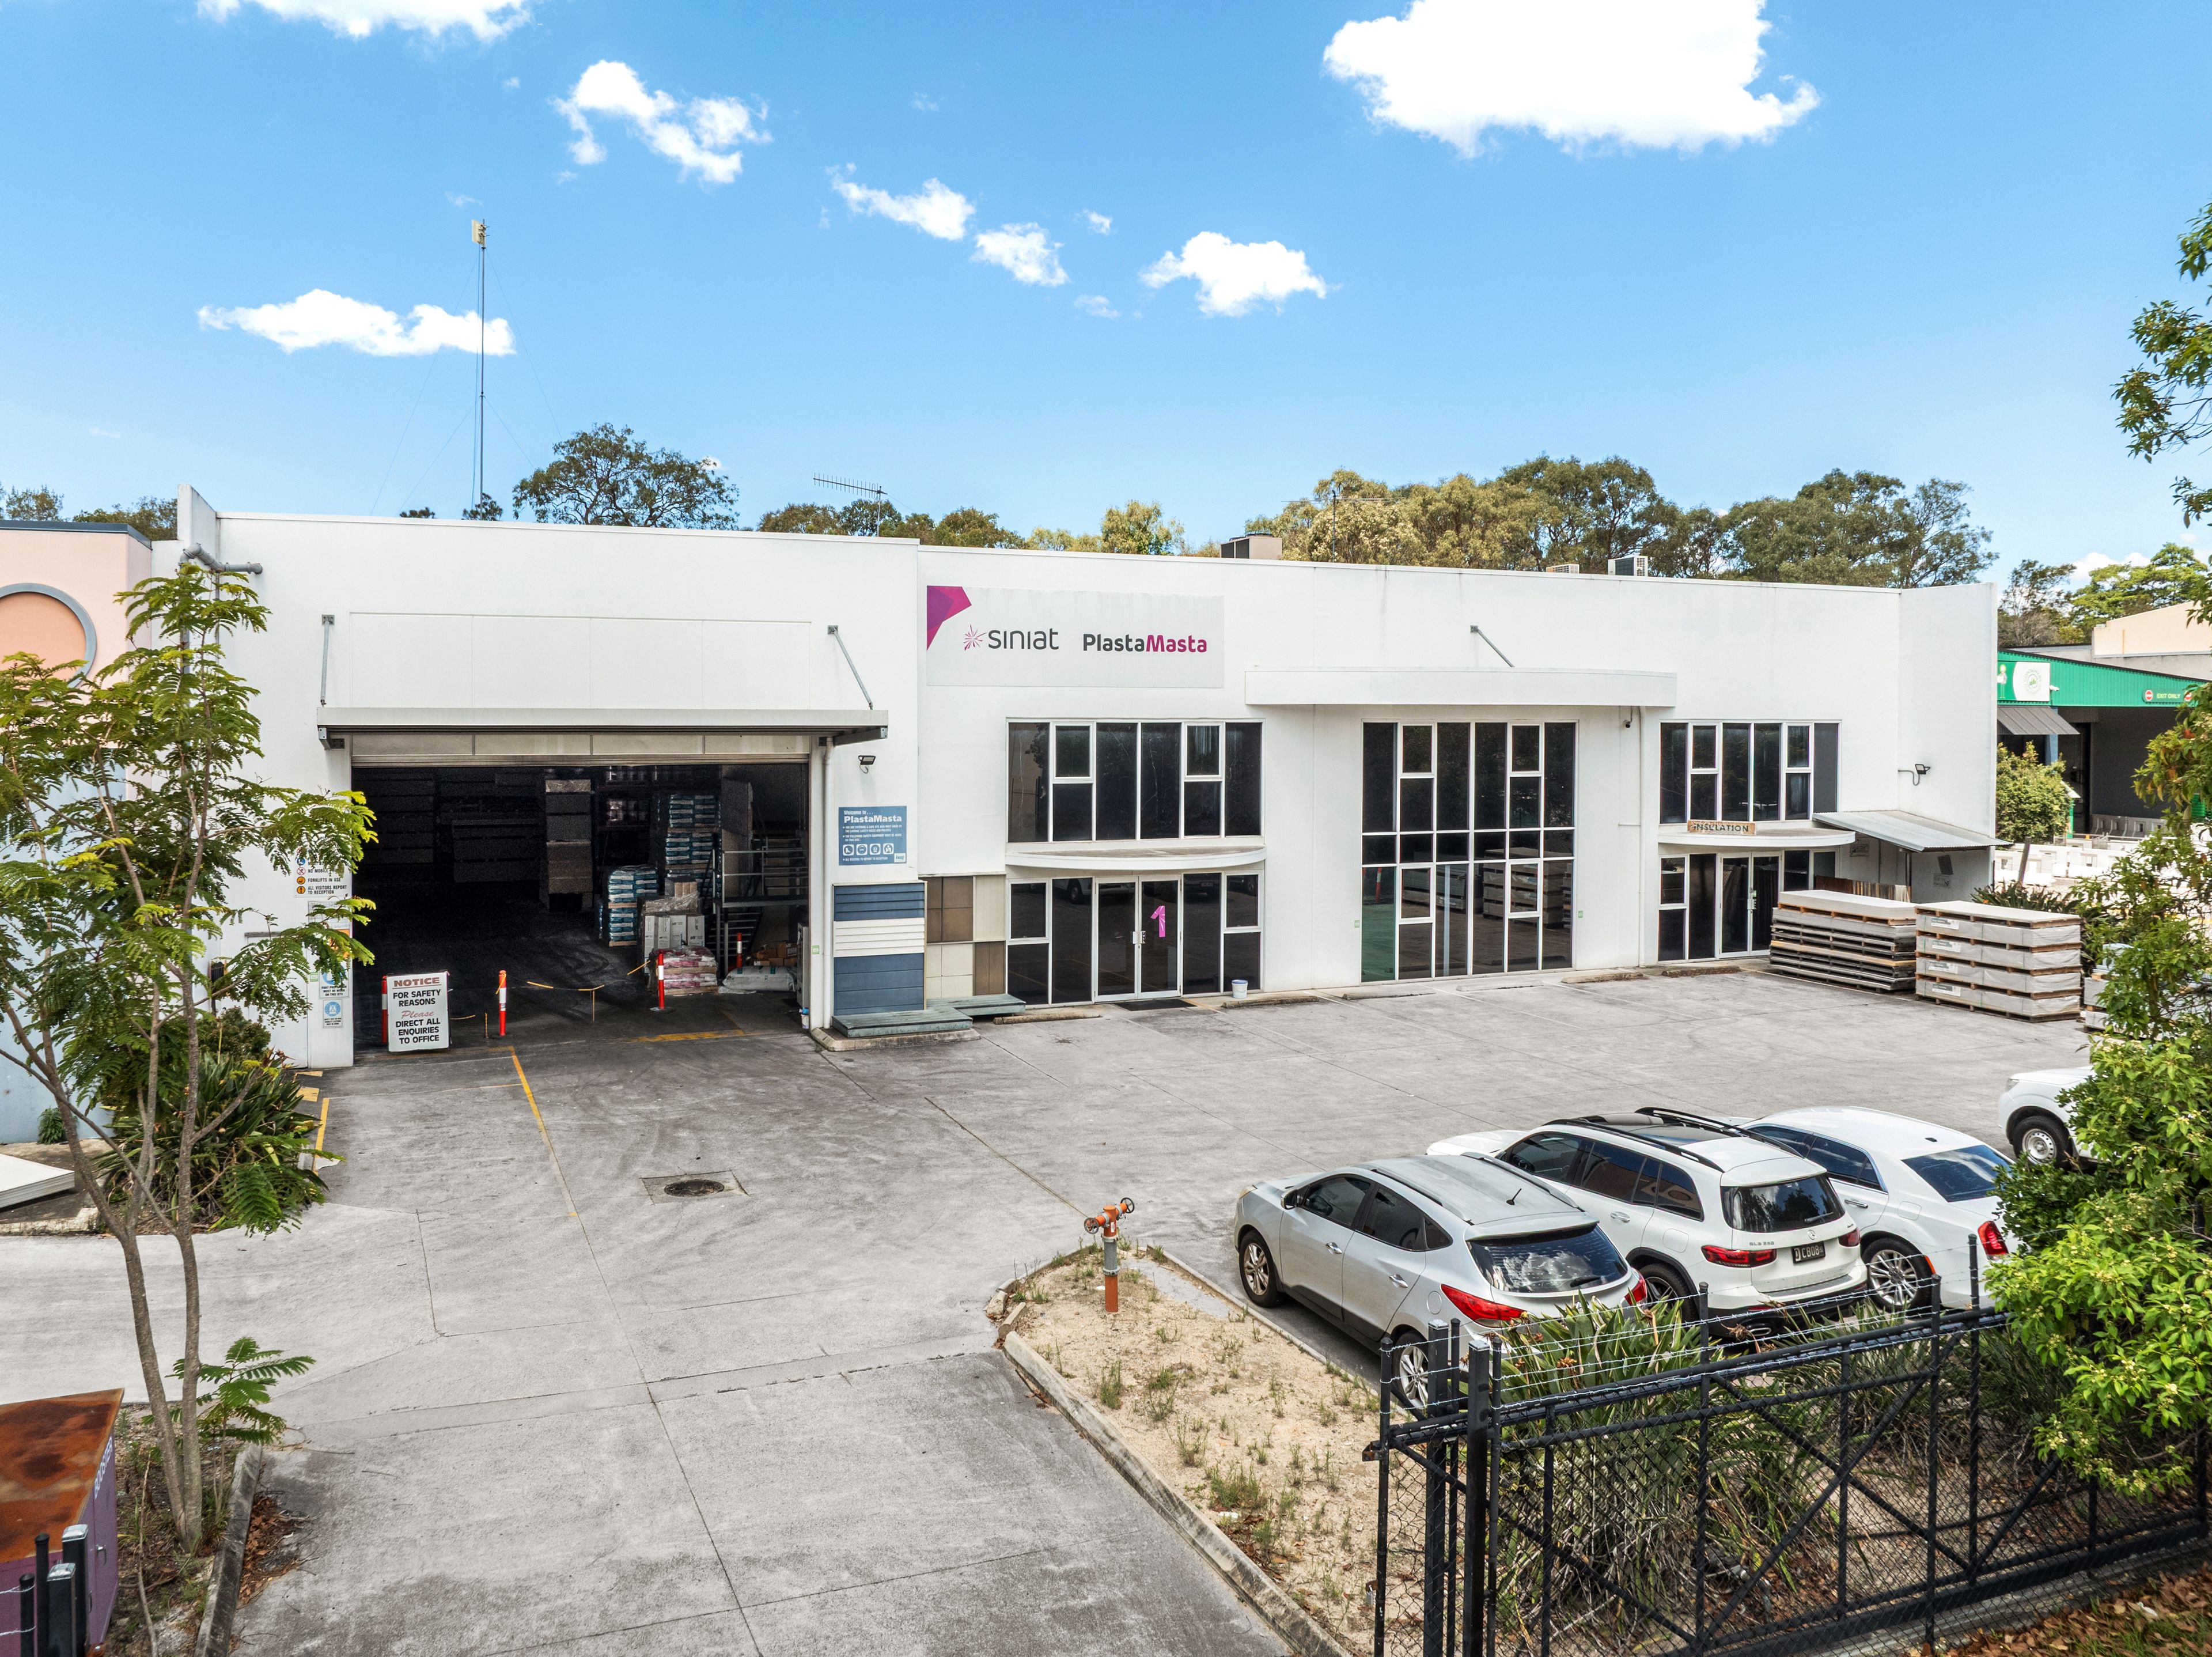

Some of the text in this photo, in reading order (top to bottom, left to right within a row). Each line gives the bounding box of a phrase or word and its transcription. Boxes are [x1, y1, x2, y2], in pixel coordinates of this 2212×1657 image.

[988, 628, 1059, 650] siniat
[1083, 633, 1207, 653] PlastaMasta
[844, 815, 902, 823] PlastaMasta
[394, 977, 440, 987] NOTICE
[411, 989, 441, 998] SAFETY
[399, 998, 435, 1007] REASONS
[402, 1011, 434, 1019] Please
[396, 1019, 423, 1028] DIRECT
[399, 1027, 439, 1036] ENQUIRIES
[412, 1035, 440, 1043] OFFICE
